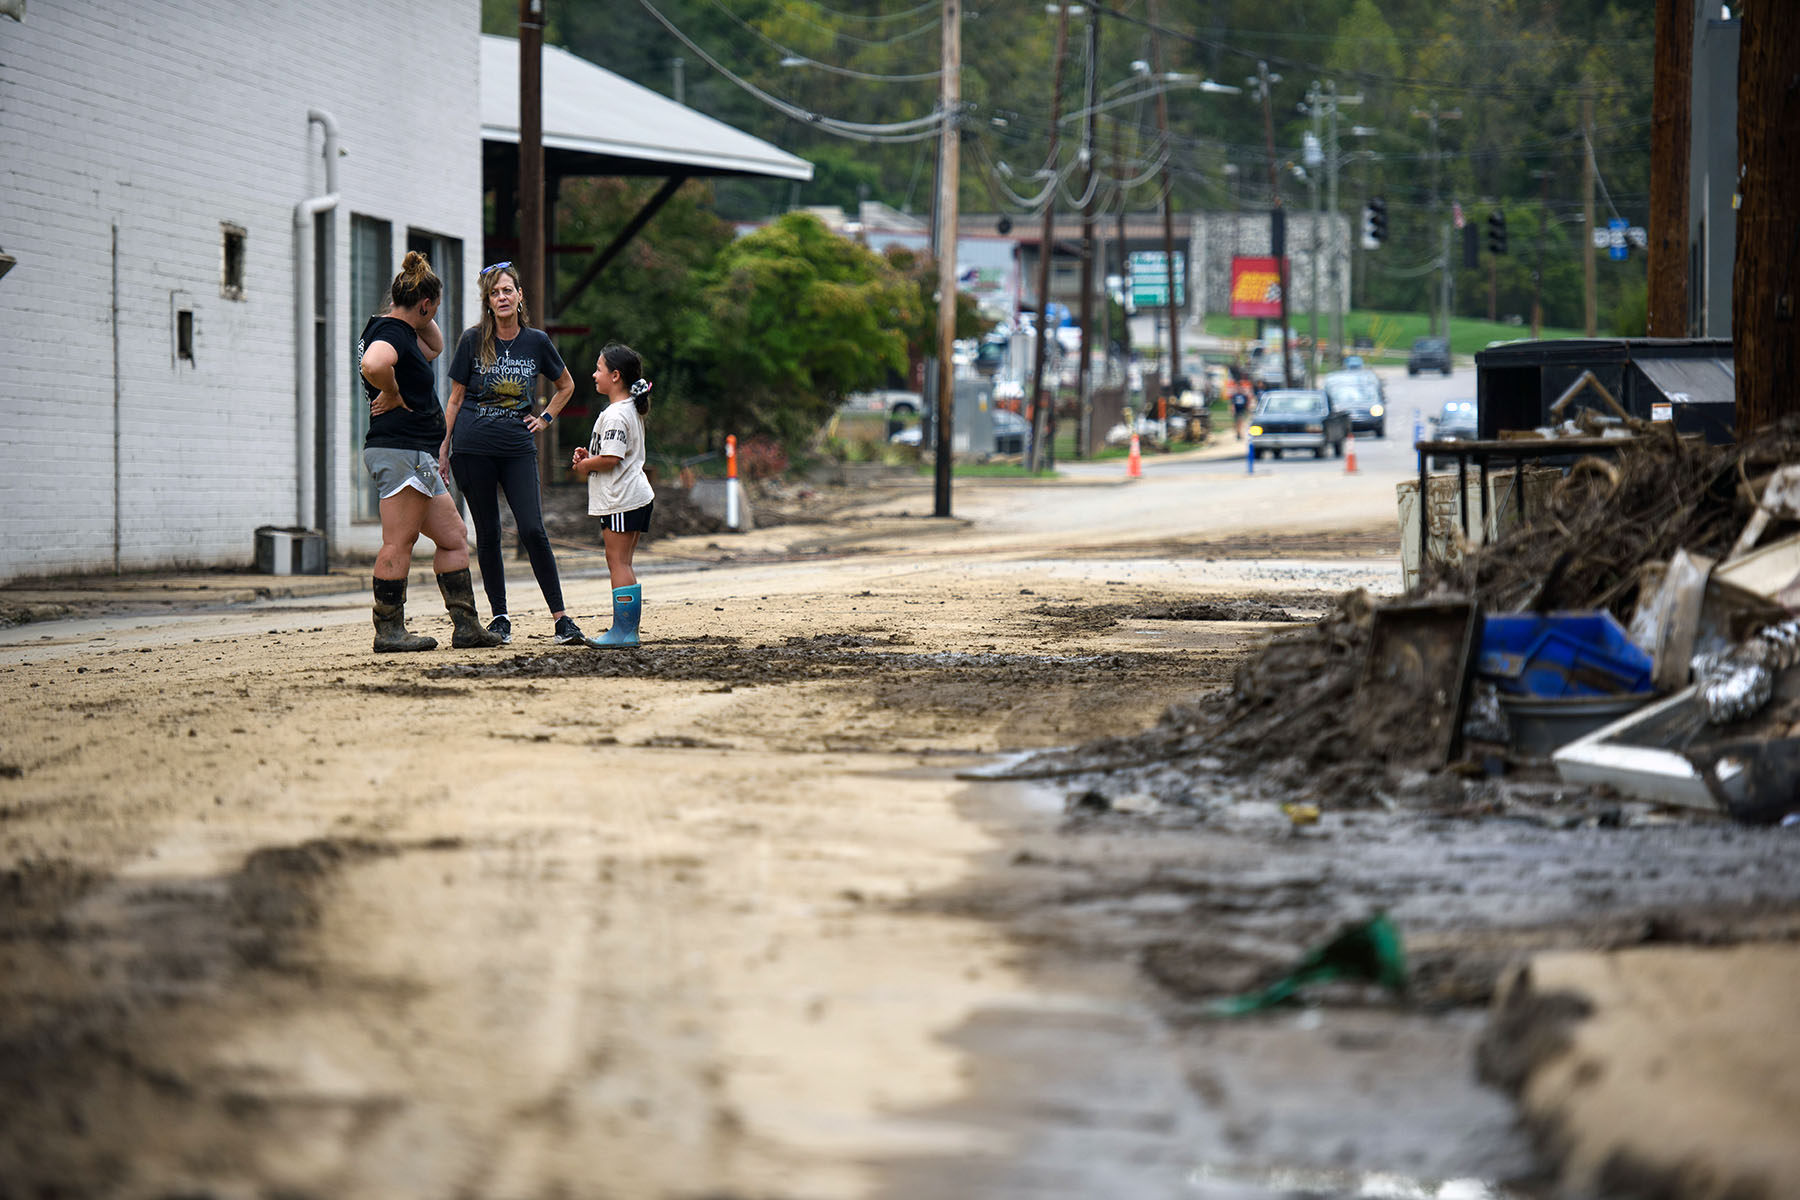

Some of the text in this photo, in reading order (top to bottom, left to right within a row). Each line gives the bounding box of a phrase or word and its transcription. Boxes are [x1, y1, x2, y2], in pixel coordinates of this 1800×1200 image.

[501, 356, 536, 370] MIRACLES
[500, 366, 521, 376] YOUR
[520, 366, 534, 378] LIFE
[616, 429, 627, 445] YOR
